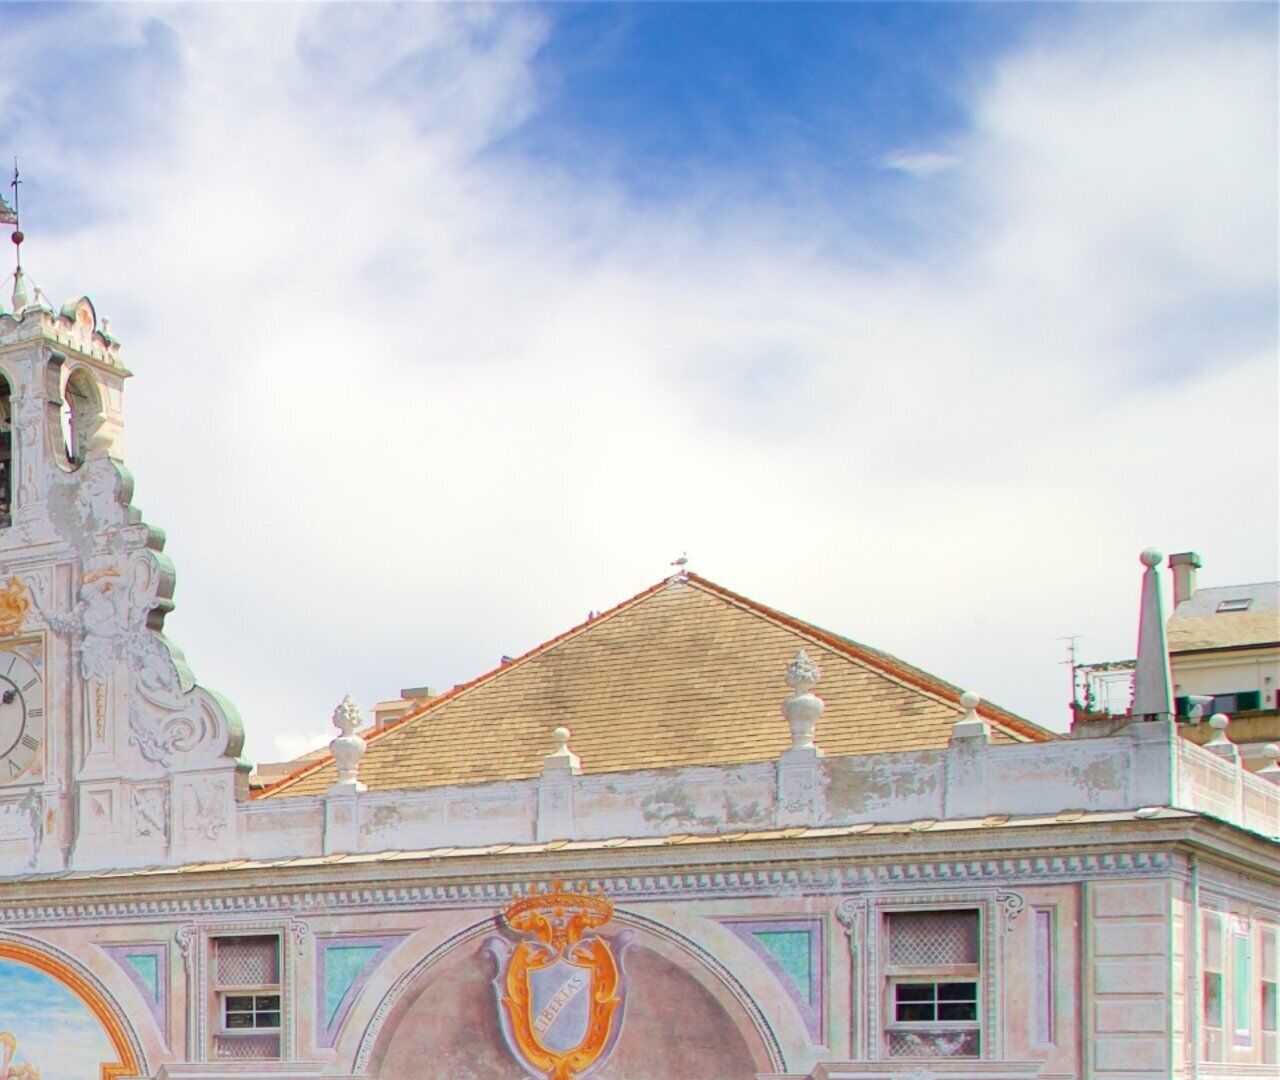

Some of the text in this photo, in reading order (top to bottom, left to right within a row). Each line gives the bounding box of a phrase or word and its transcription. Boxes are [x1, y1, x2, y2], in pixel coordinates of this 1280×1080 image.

[7, 657, 17, 675] I
[23, 678, 38, 691] II
[27, 708, 43, 718] III
[534, 975, 584, 1034] LIBERTAS
